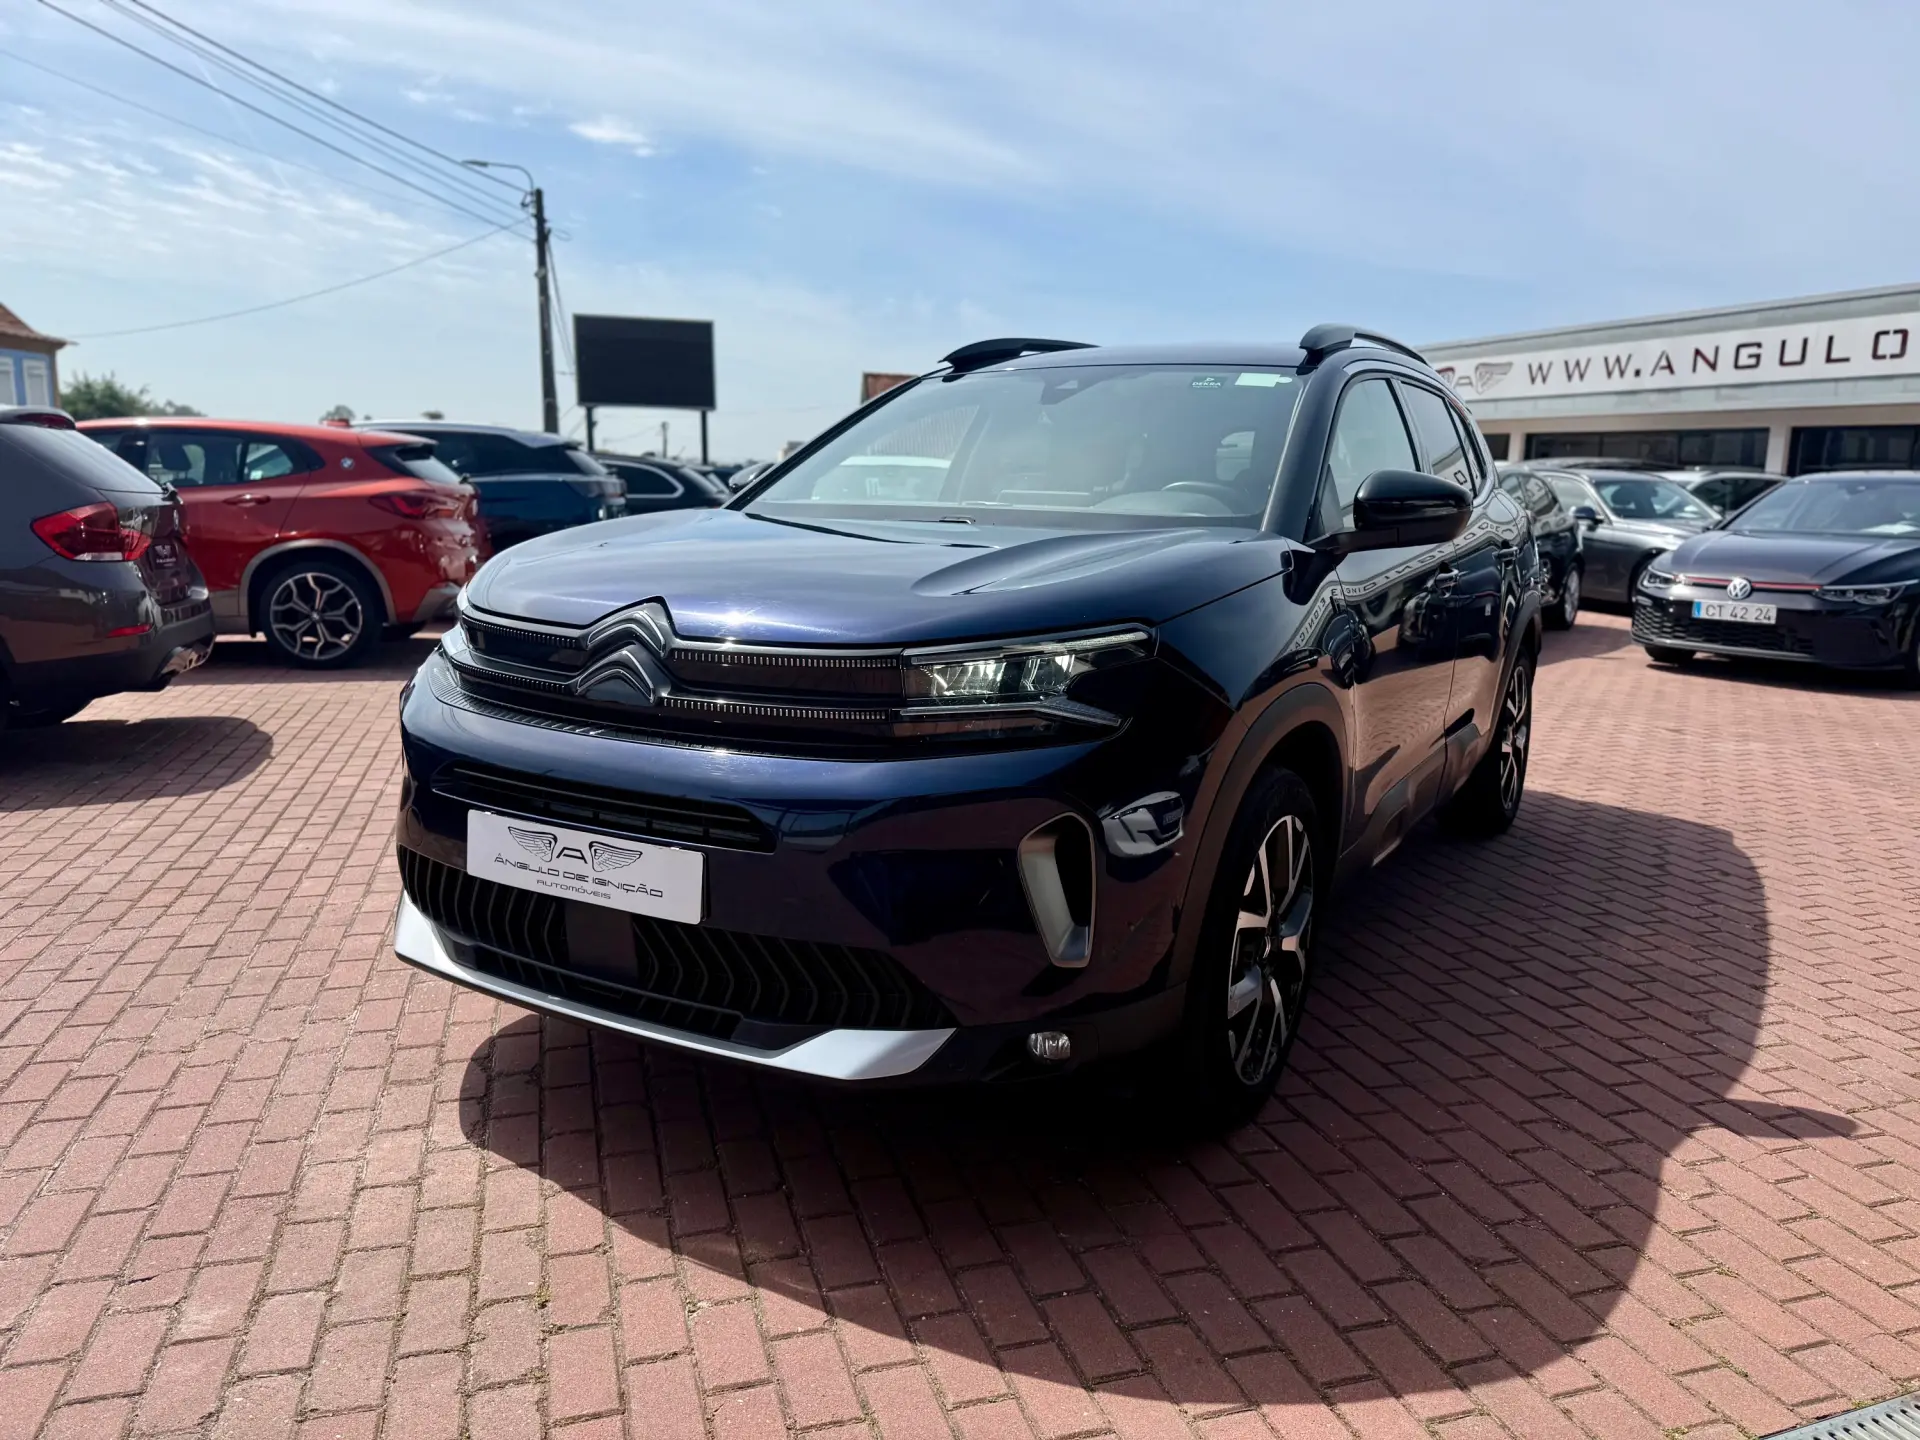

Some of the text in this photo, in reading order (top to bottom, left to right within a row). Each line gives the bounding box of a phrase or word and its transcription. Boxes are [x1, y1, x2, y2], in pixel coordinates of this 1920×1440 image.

[1528, 328, 1909, 386] WWW.ANGULO
[1705, 604, 1771, 621] CT 42 24
[494, 853, 663, 898] ÂNGULO DE IGNIÇÃO
